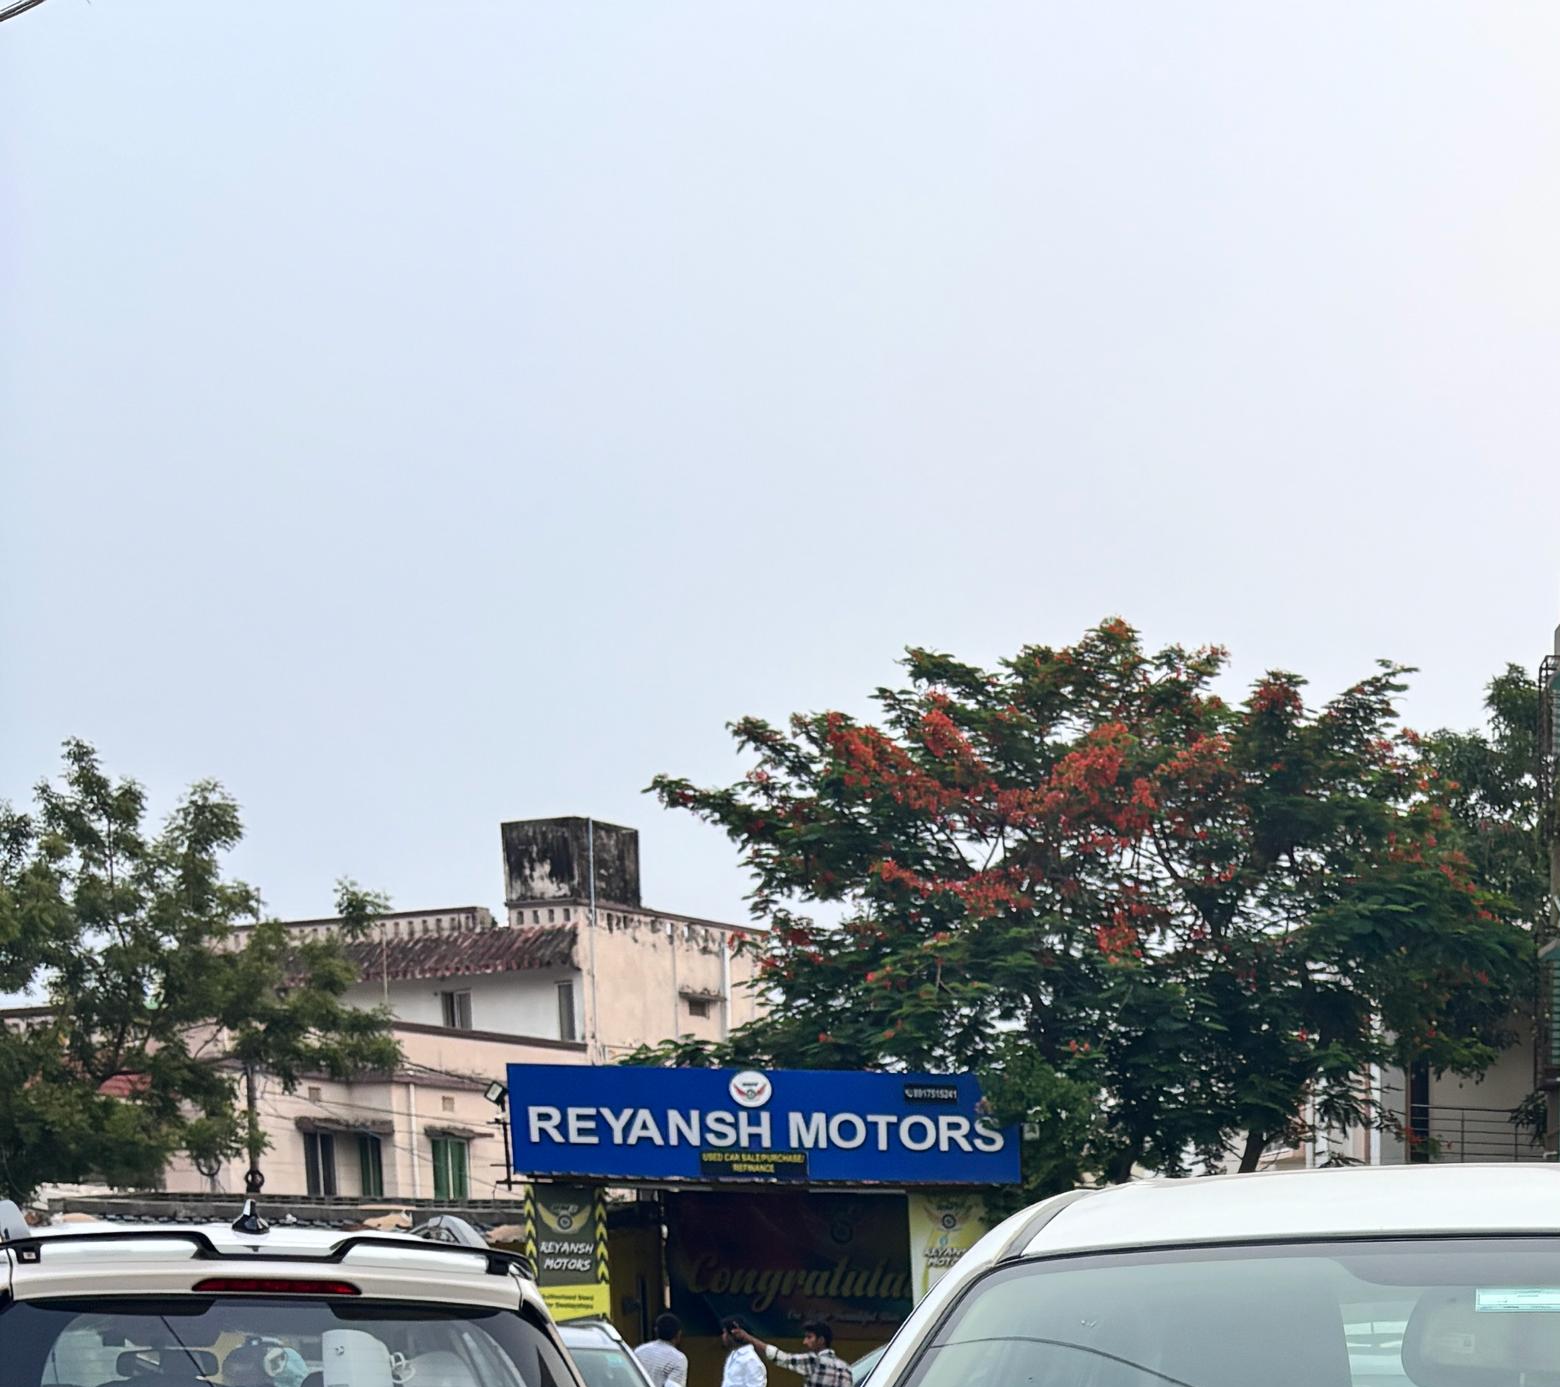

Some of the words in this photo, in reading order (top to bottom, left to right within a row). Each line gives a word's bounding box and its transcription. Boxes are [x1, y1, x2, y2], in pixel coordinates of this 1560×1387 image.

[527, 1105, 771, 1149] REYANSH
[789, 1112, 1004, 1153] MOTORS
[540, 1241, 595, 1255] REYANSH
[543, 1258, 592, 1272] MOTORS
